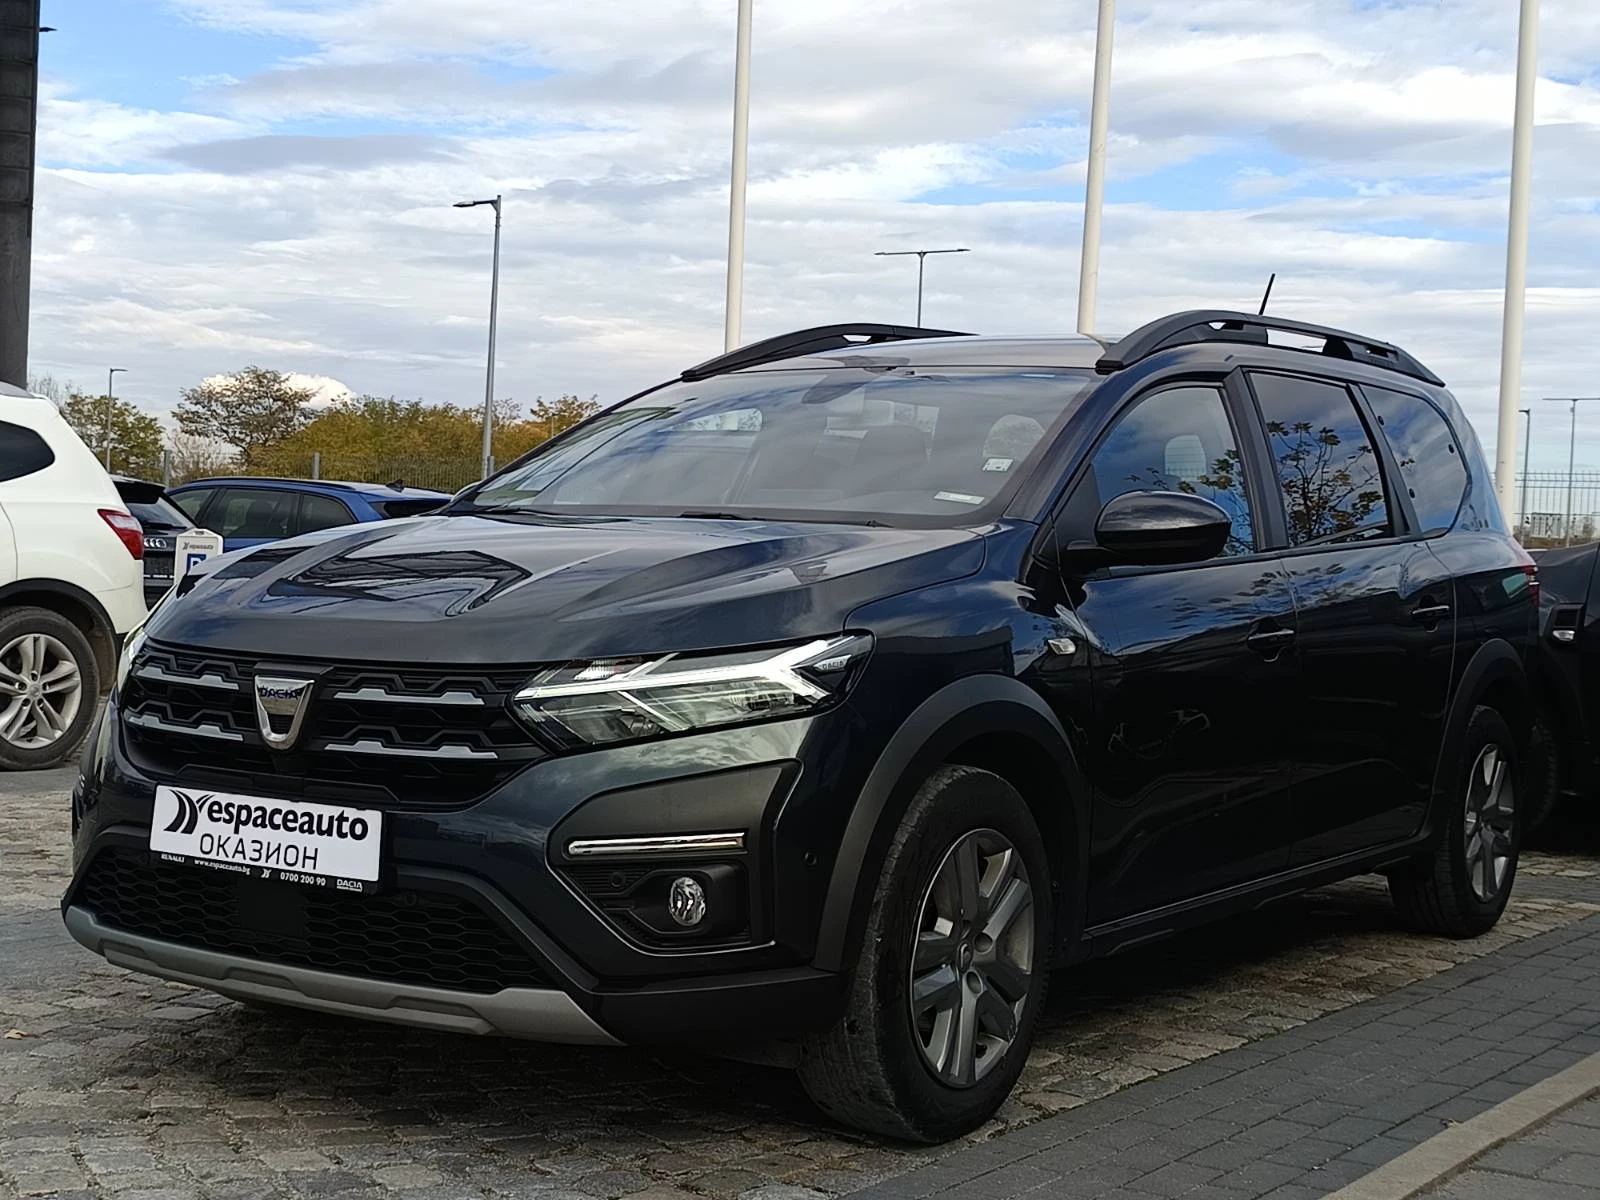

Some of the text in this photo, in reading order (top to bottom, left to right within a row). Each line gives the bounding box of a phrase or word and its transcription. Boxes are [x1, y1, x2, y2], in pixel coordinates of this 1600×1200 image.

[822, 660, 845, 670] DACIA
[260, 687, 299, 699] DACIA
[207, 800, 369, 841] espaceauto
[200, 833, 319, 870] ОКАЗИОН
[280, 872, 299, 882] 0700
[300, 875, 315, 884] 200
[316, 877, 326, 886] 90
[336, 879, 363, 889] DACIA
